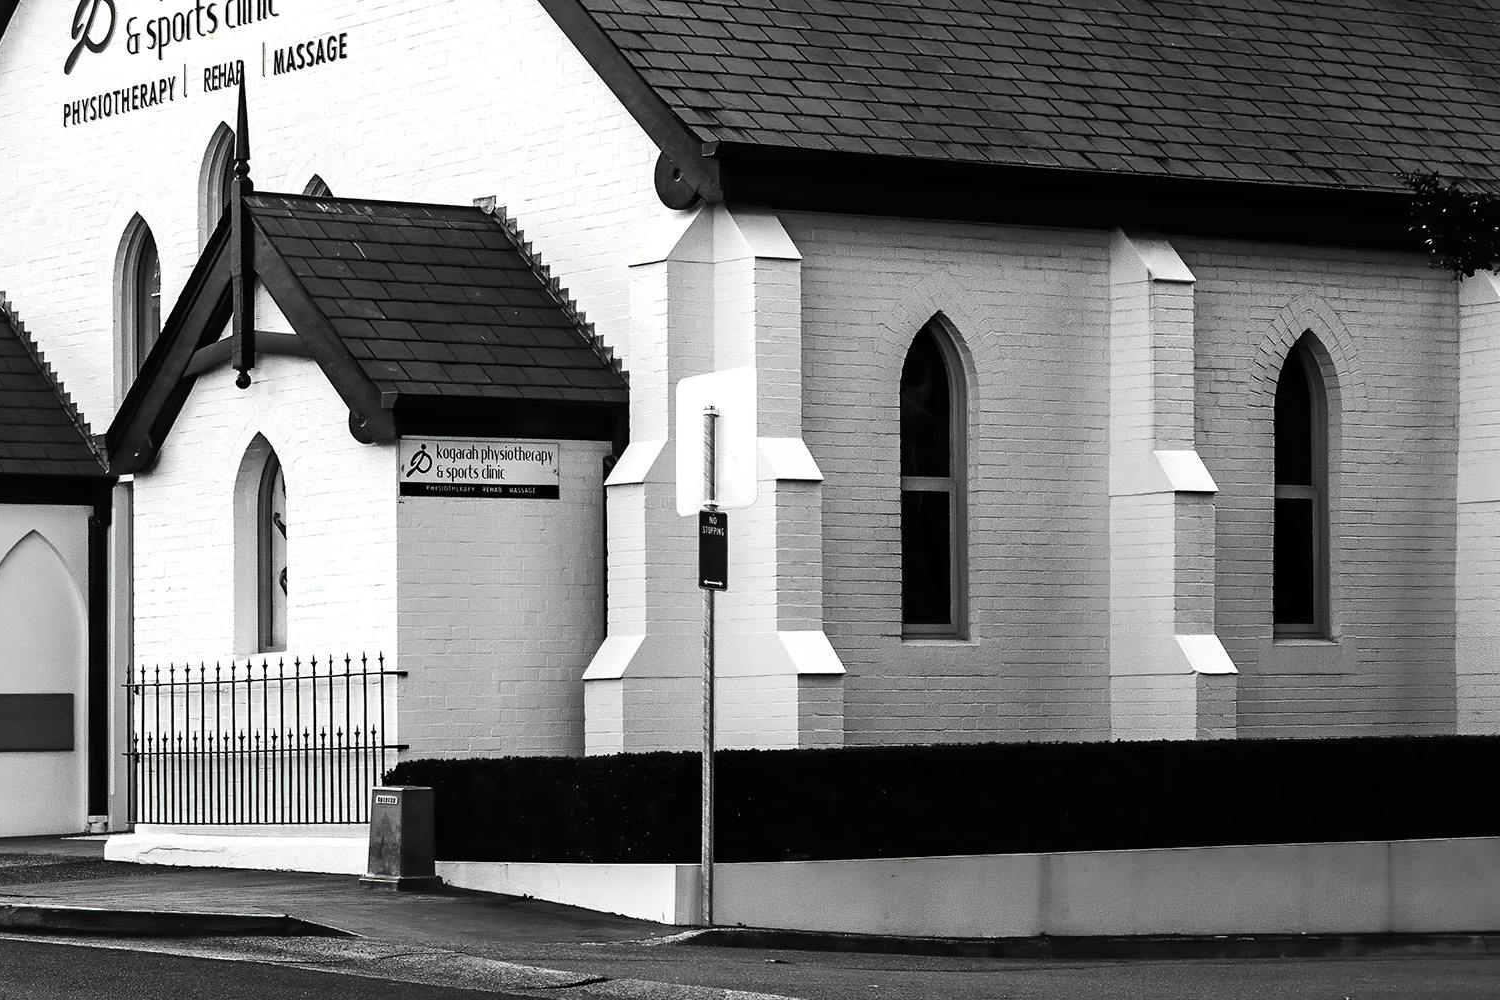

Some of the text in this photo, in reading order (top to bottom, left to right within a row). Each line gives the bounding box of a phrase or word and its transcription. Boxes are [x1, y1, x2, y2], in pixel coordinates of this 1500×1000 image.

[126, 16, 141, 55] &
[62, 75, 177, 128] PHYSIOTHERAPY
[272, 32, 349, 76] MASSAGE
[436, 443, 554, 466] kogarah physiotherapy
[436, 464, 506, 482] & sports clinic
[425, 485, 476, 493] PHYSIOTHERAPY
[482, 486, 503, 494] REHAB
[708, 516, 718, 525] NO
[701, 525, 725, 537] STOPPING
